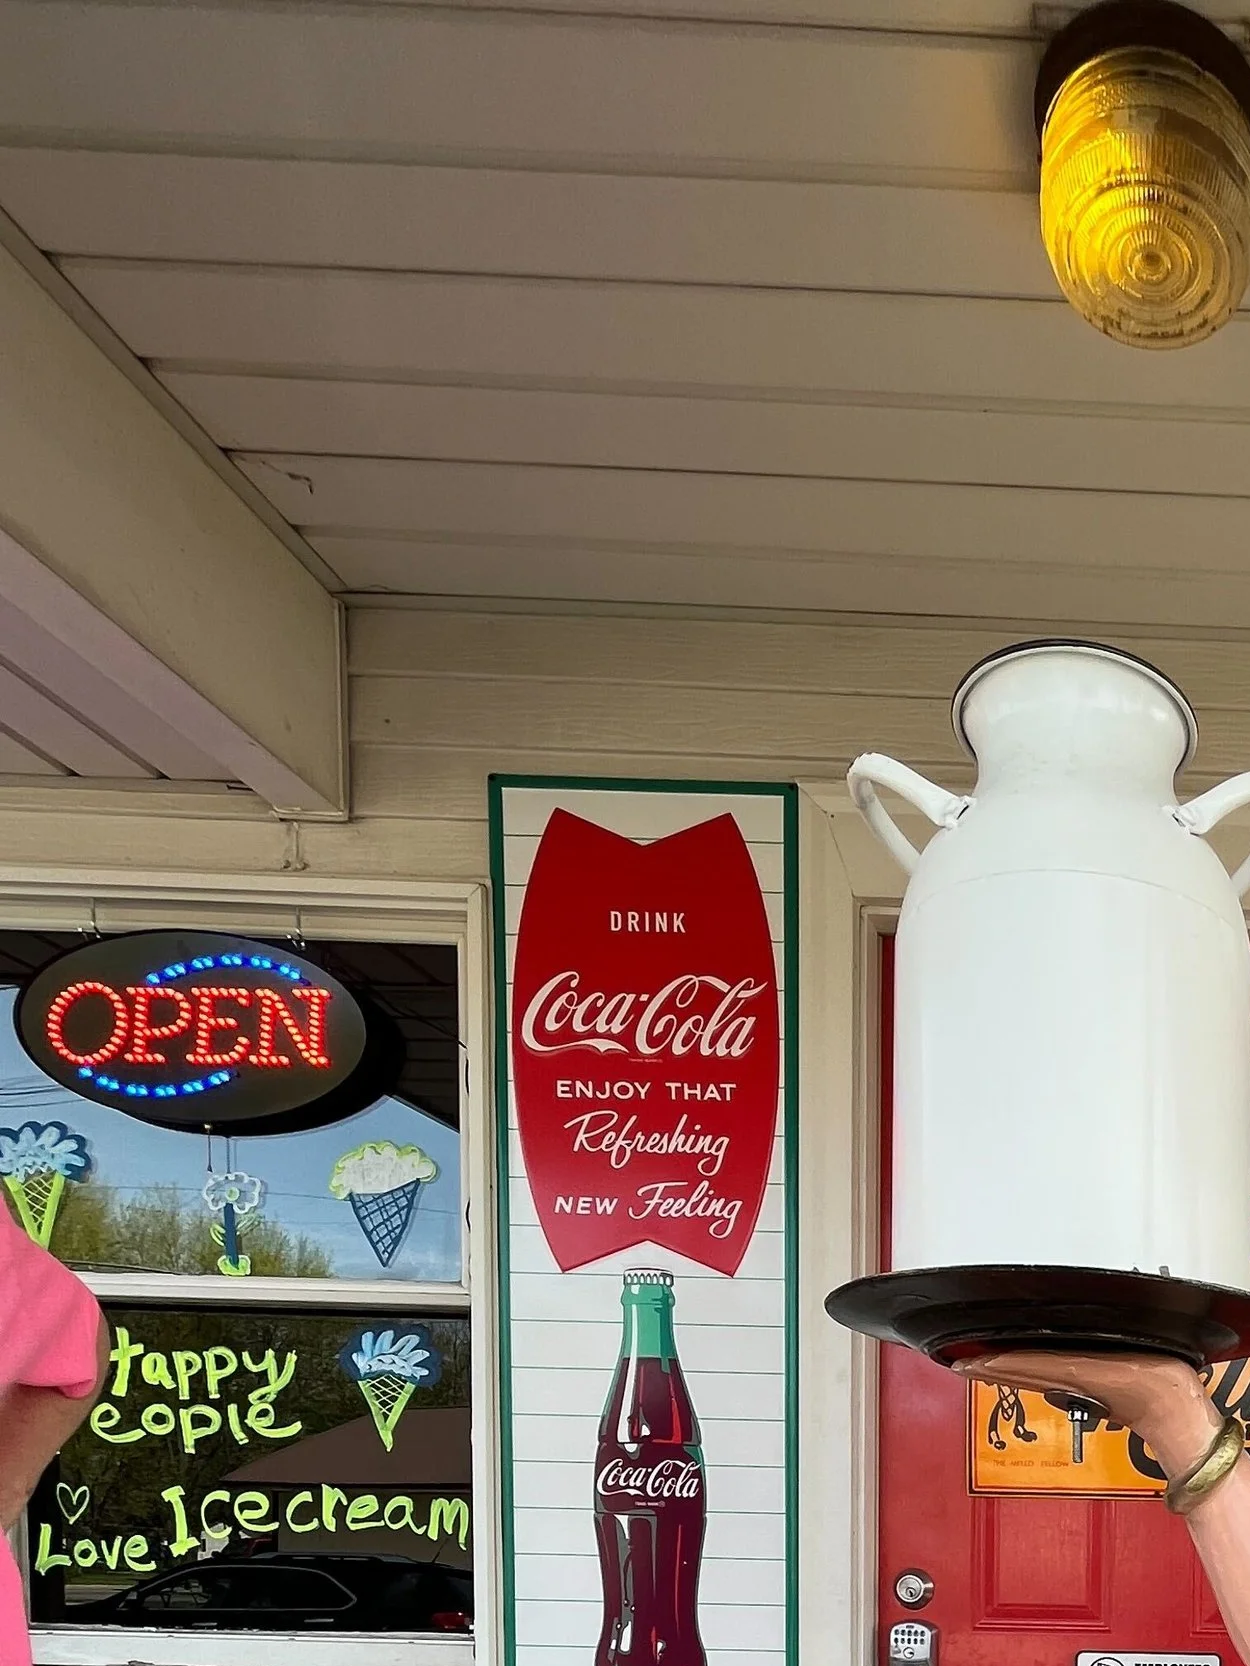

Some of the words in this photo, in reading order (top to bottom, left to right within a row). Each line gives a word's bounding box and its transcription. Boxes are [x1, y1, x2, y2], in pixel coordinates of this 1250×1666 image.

[610, 911, 686, 933] DRINK
[46, 980, 333, 1068] OPEN
[521, 971, 768, 1058] Coca-Cola
[556, 1080, 651, 1101] ENJOY
[665, 1082, 736, 1102] THAT
[563, 1110, 730, 1176] Refreshing
[554, 1196, 618, 1216] NEW
[628, 1180, 743, 1240] Feeling
[90, 1402, 302, 1455] eople
[597, 1458, 701, 1498] Coca-Cola
[34, 1523, 157, 1576] Love
